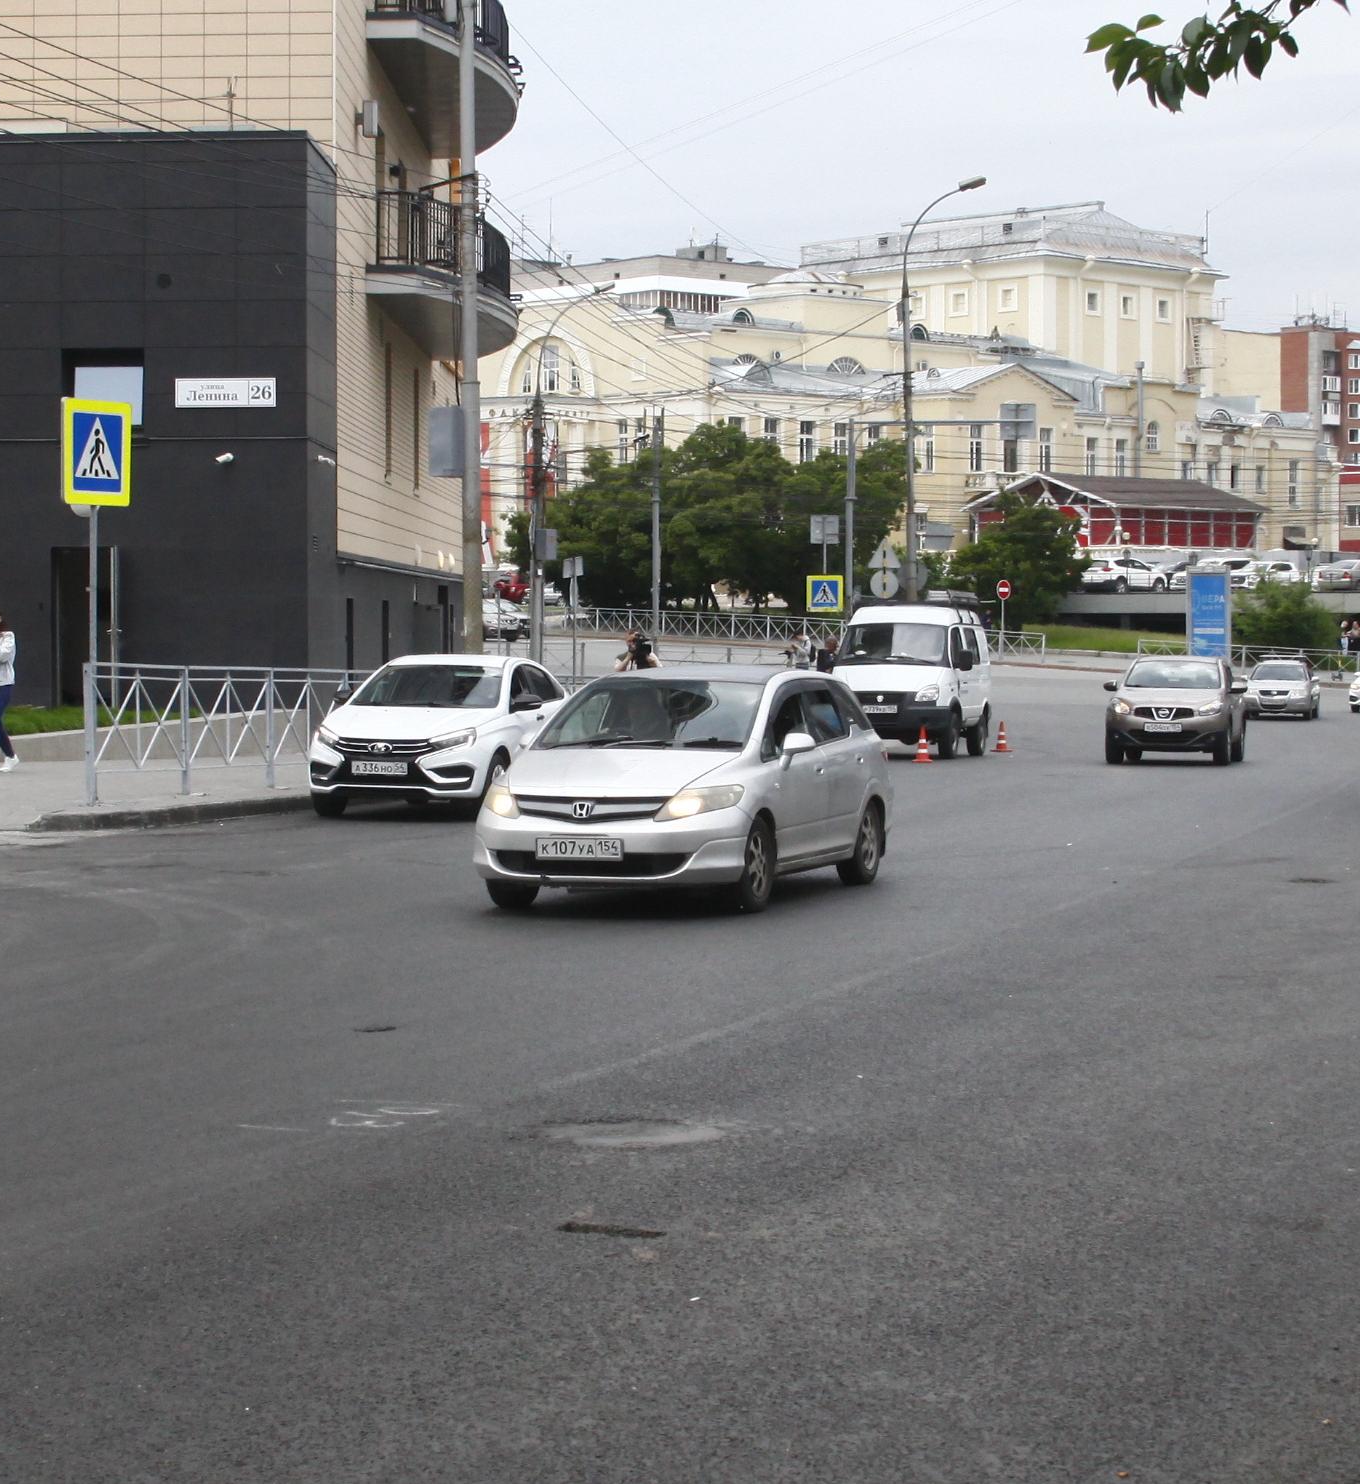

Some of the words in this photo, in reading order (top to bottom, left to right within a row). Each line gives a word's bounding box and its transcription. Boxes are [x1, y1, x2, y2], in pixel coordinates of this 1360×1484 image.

[186, 390, 238, 401] Ленина
[251, 385, 272, 400] 26
[541, 841, 594, 855] К107УА
[597, 841, 618, 852] 154
